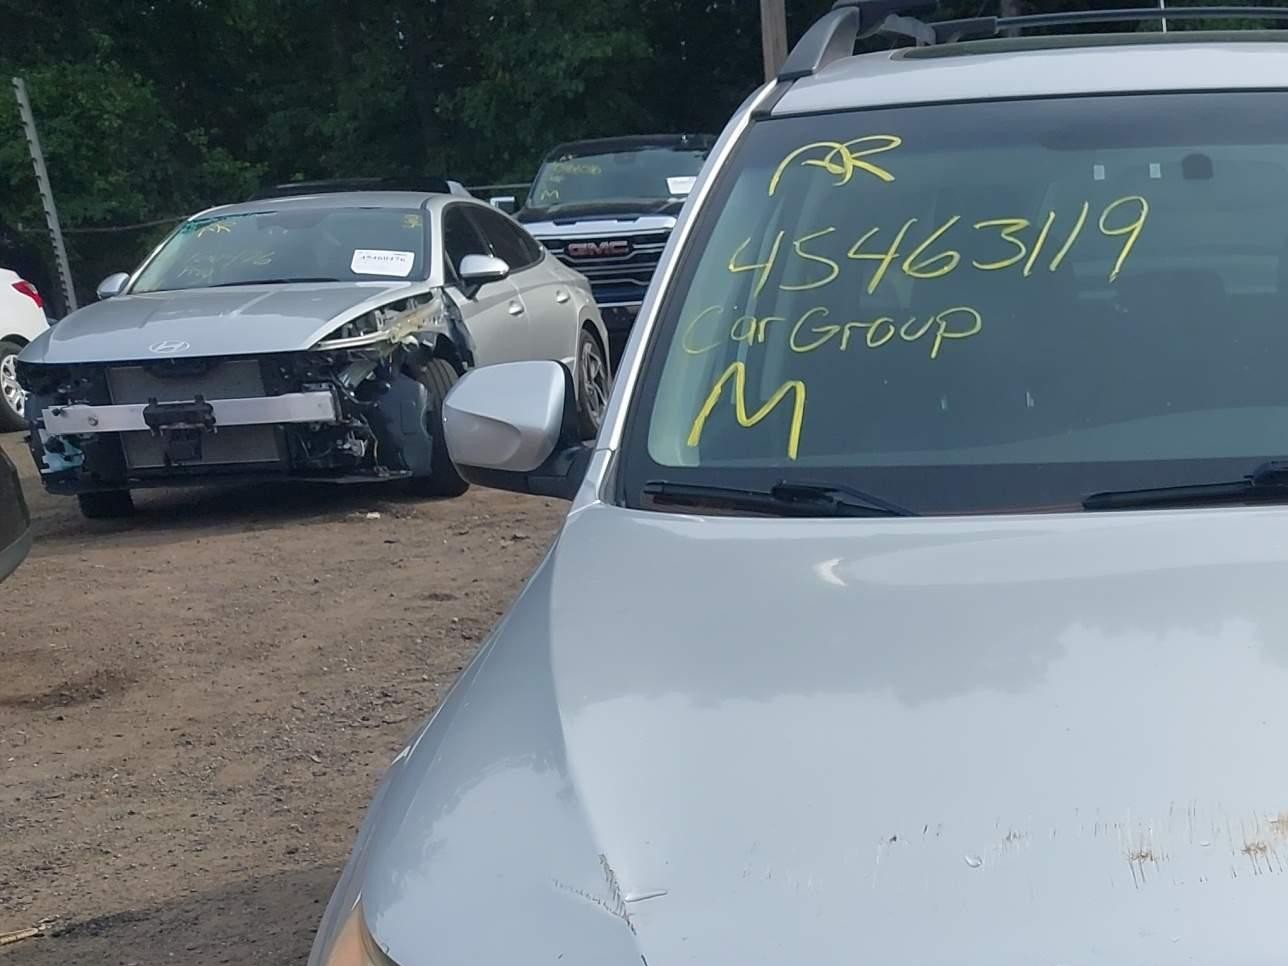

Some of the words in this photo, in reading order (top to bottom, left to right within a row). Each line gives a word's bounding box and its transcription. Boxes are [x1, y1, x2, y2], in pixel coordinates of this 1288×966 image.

[567, 240, 630, 257] GMC
[729, 196, 1149, 296] 45463119
[687, 361, 806, 460] M
